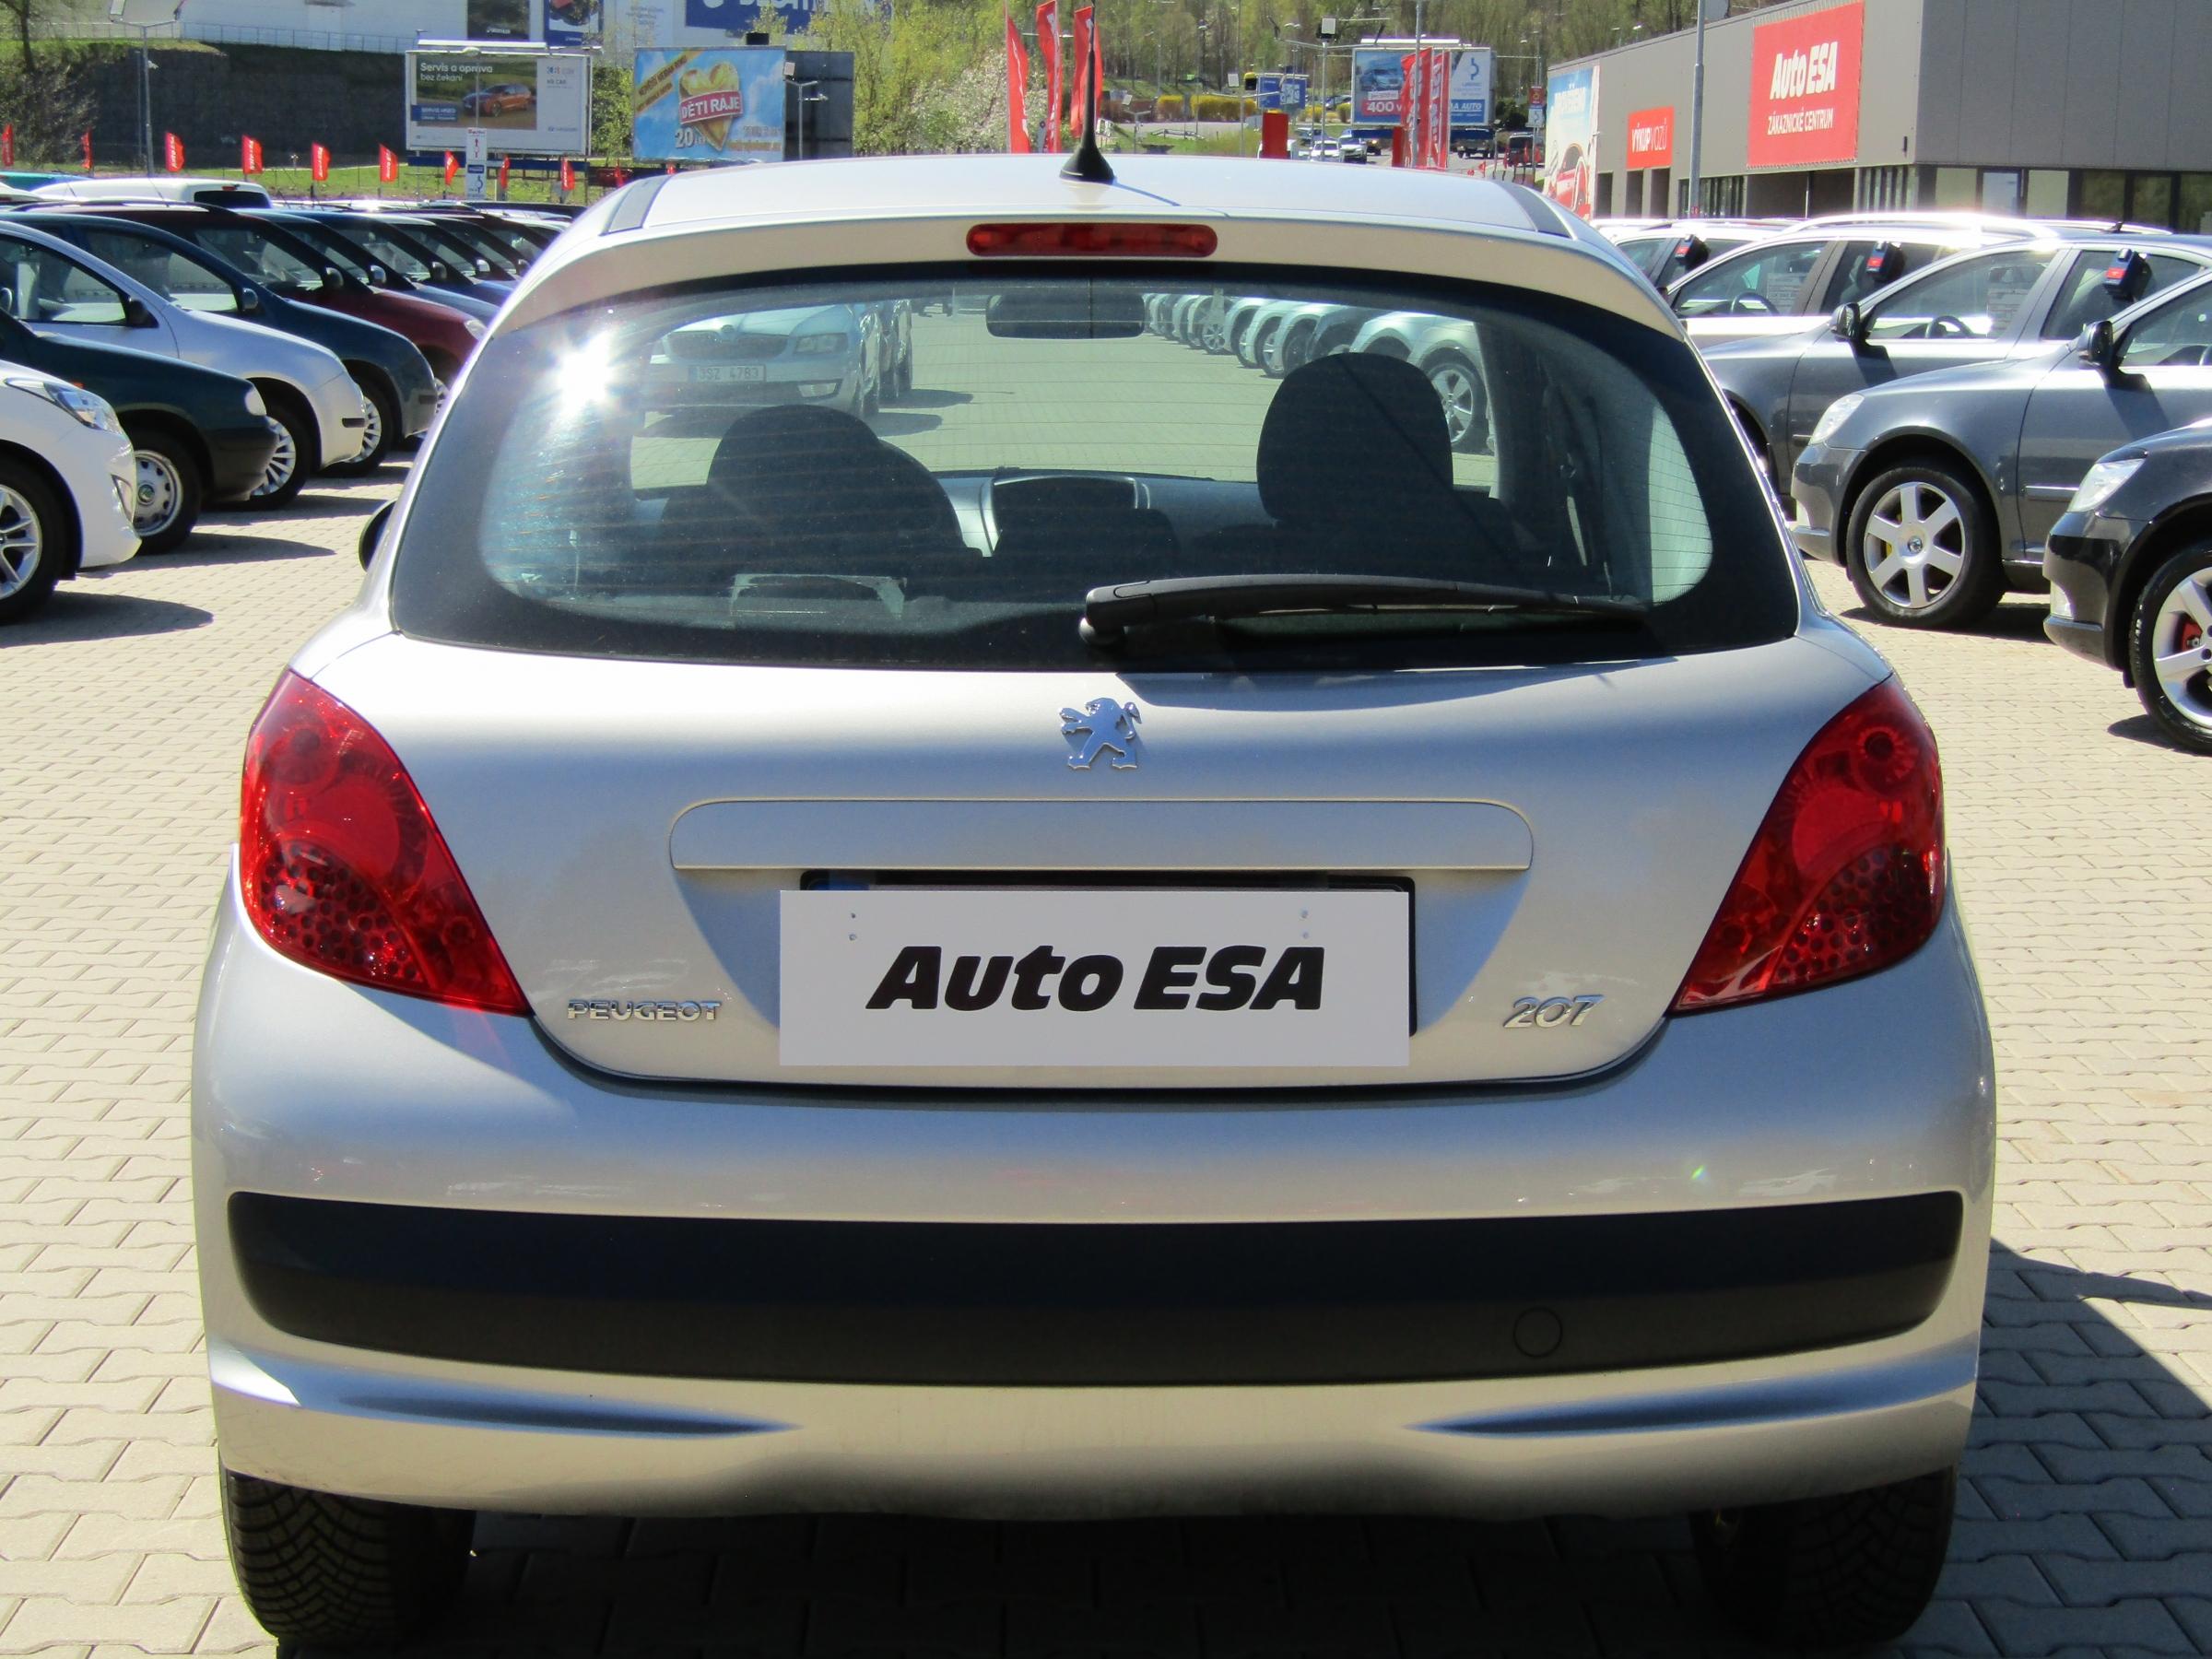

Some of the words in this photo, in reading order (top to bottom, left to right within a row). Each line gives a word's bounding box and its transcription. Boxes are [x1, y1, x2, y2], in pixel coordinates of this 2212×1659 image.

[420, 62, 448, 72] Servis
[1770, 50, 1806, 100] Auto
[1806, 41, 1838, 94] ESA
[681, 100, 708, 119] DĚTI
[1367, 101, 1394, 112] 400
[1767, 107, 1805, 135] ZÁKAZNICKÉ
[1804, 108, 1834, 132] CENTRUM
[675, 127, 694, 148] 20
[1631, 121, 1651, 154] VÝKUP
[865, 945, 1124, 1012] Auto
[1133, 945, 1325, 1011] ESA
[567, 999, 722, 1021] PEUGEOT
[1502, 994, 1605, 1029] 207
